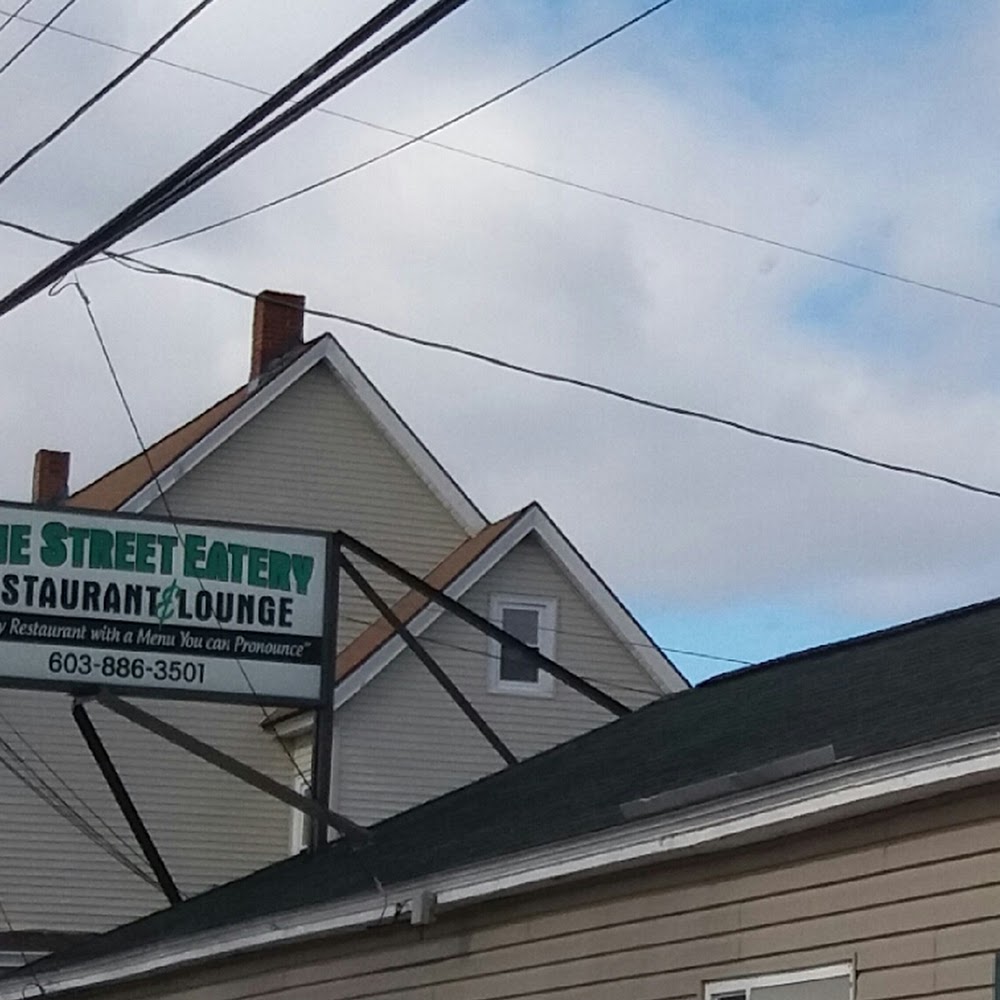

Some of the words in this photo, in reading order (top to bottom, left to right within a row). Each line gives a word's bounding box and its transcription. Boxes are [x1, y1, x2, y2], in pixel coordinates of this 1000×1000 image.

[40, 521, 178, 576] STREET
[183, 533, 314, 595] EATERY
[178, 590, 294, 628] LOUNGE
[9, 617, 87, 640] Restaurant
[91, 626, 120, 643] with
[123, 631, 133, 644] a
[137, 628, 175, 648] Menu
[179, 631, 203, 649] You
[205, 637, 230, 651] can
[48, 651, 206, 684] 603-886-3501
